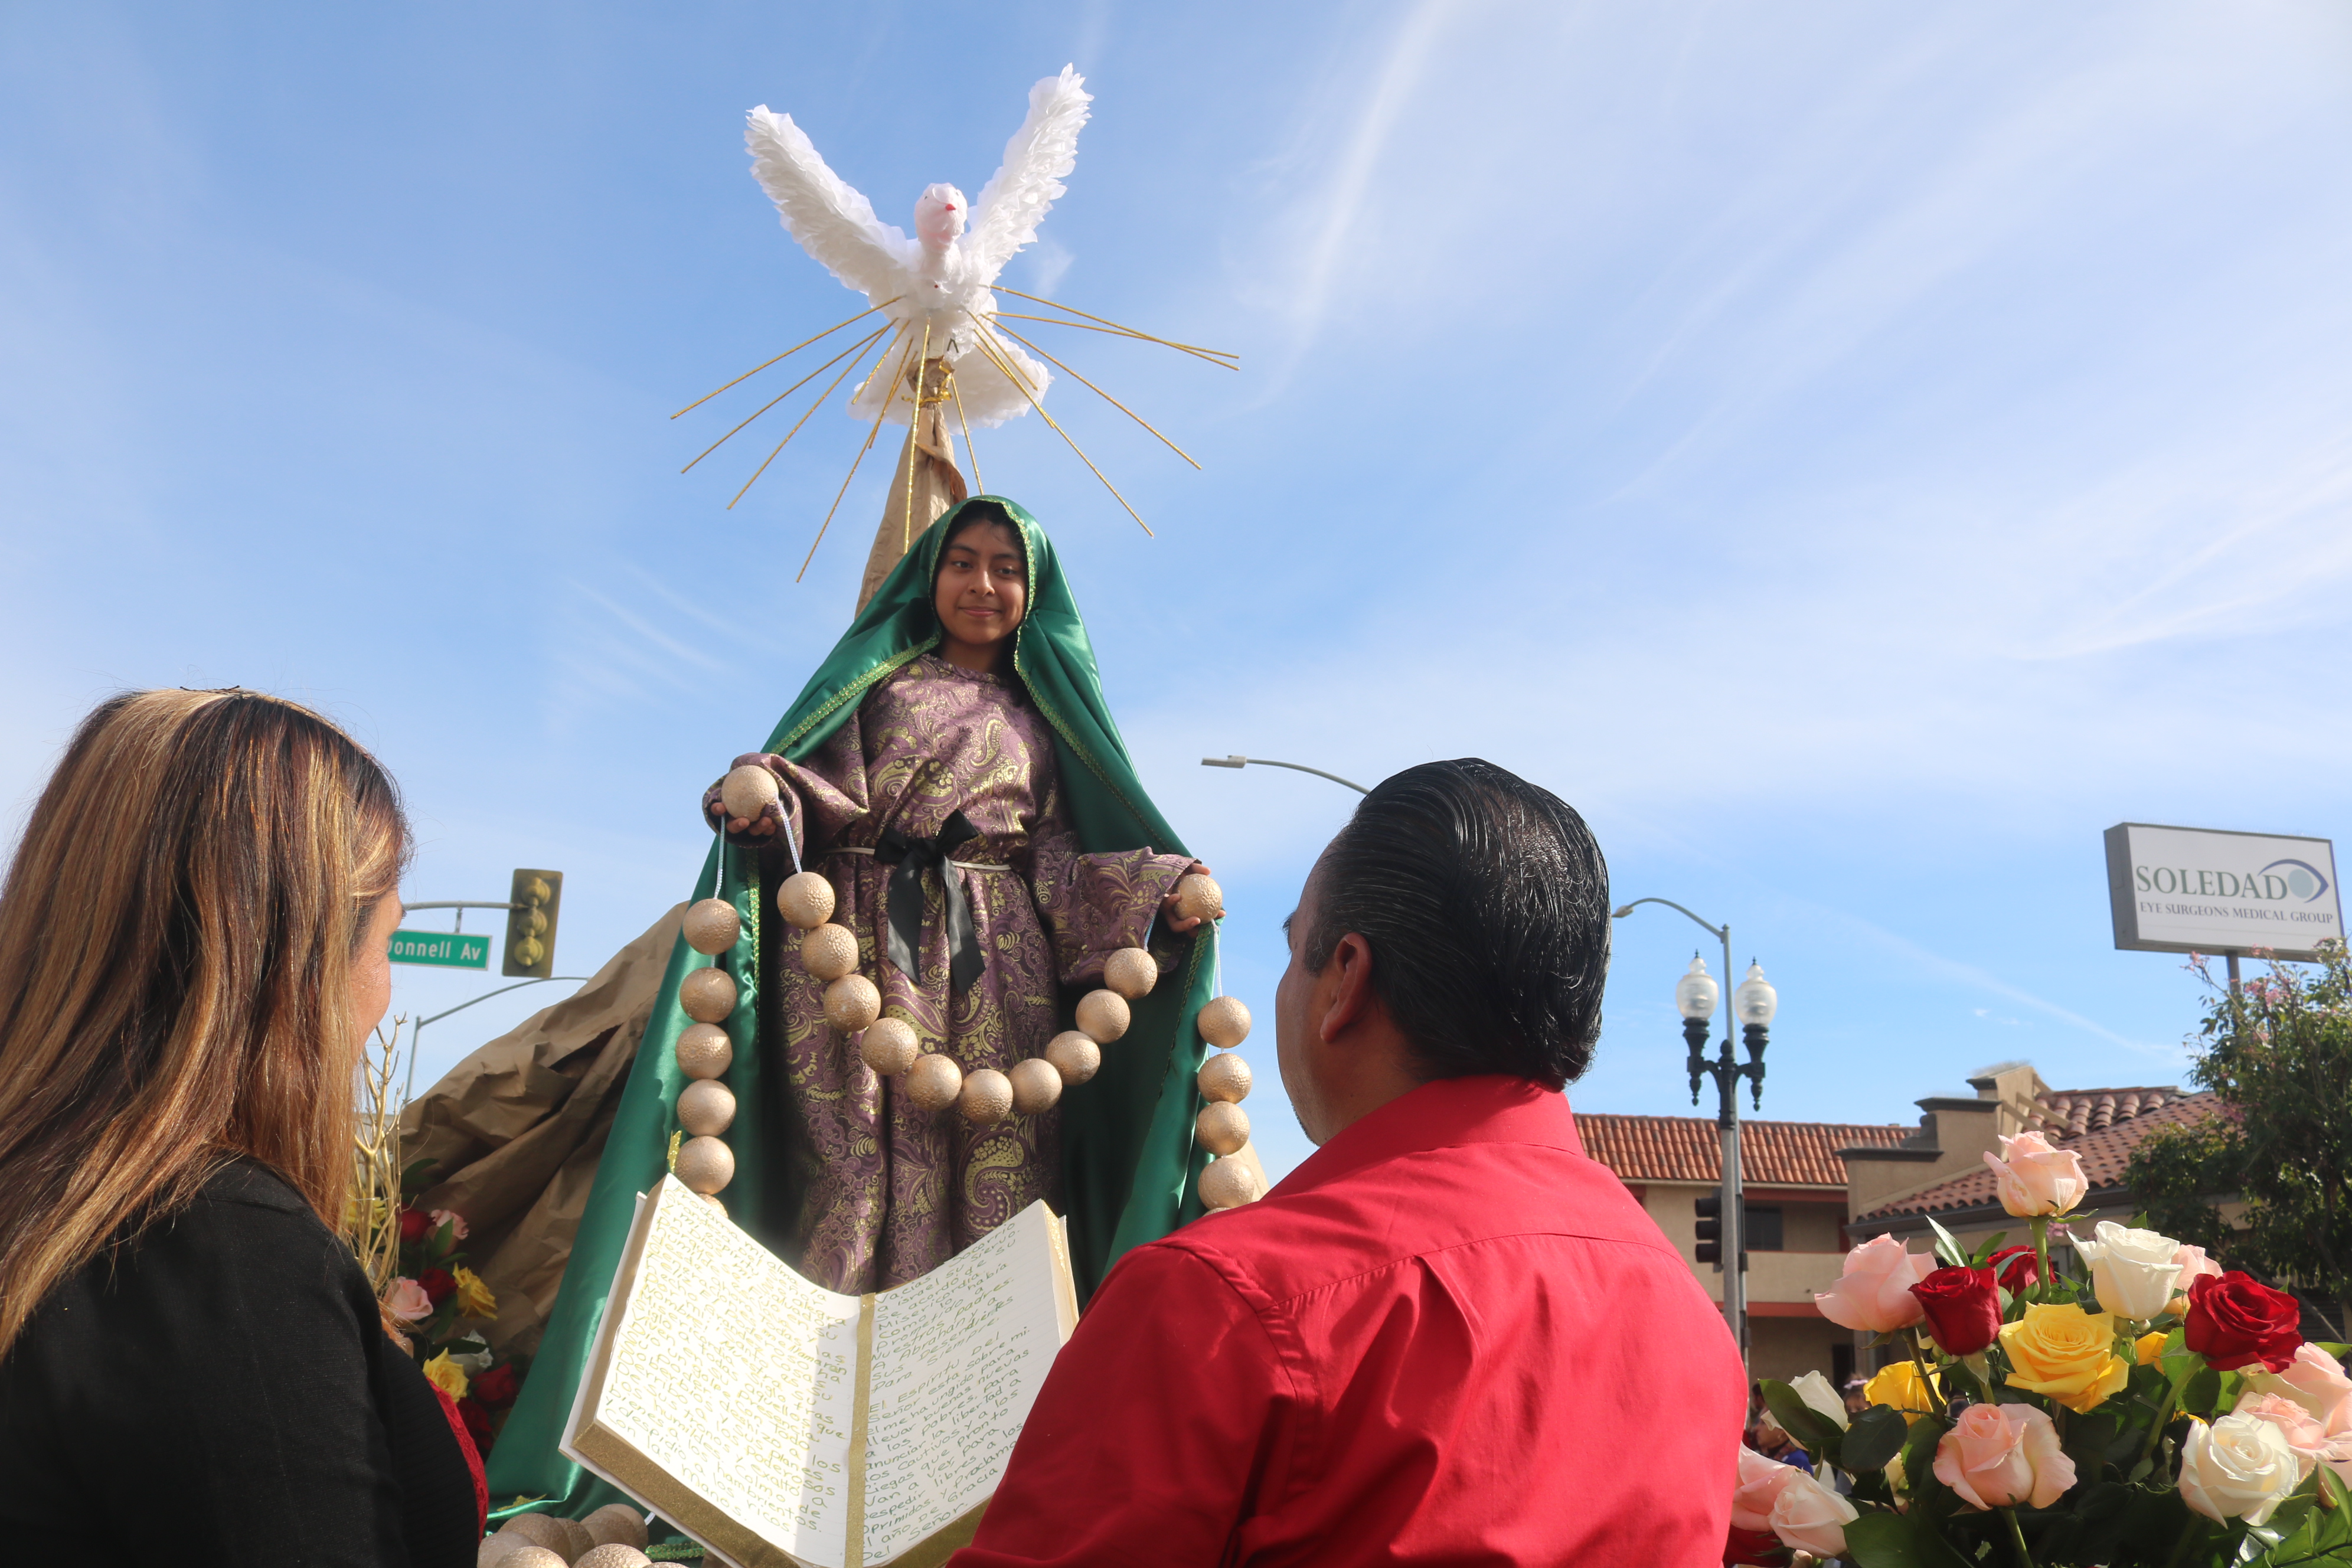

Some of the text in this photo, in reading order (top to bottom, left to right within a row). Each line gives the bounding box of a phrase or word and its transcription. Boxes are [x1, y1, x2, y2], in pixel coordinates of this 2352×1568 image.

[2136, 865, 2288, 900] SOLEDAD
[2140, 901, 2333, 924] EYE SURGEONS MEDICAL GROUP
[460, 943, 481, 961] Av
[664, 1188, 730, 1243] Grandeza
[769, 1269, 823, 1305] Señor
[673, 1185, 826, 1301] Proclama mi alma la
[645, 1259, 698, 1301] hecho
[648, 1242, 756, 1327] Generaciones
[655, 1224, 791, 1329] humilde esclava
[680, 1213, 702, 1229] mi
[705, 1232, 759, 1276] espíritu
[792, 1298, 846, 1326] alegra
[731, 1263, 752, 1279] mi
[965, 1260, 986, 1275] de
[651, 1234, 702, 1270] desde
[711, 1276, 753, 1313] ahora
[815, 1345, 846, 1364] las
[898, 1278, 939, 1306] israel
[940, 1298, 952, 1308] lo
[974, 1286, 984, 1295] a
[987, 1297, 998, 1306] a
[632, 1308, 676, 1347] Viven
[682, 1347, 703, 1367] en
[646, 1251, 691, 1285] Feliz
[699, 1289, 720, 1305] El
[817, 1368, 840, 1384] ha
[787, 1314, 809, 1331] en
[639, 1289, 734, 1367] Misericordia
[793, 1402, 834, 1425] tras
[871, 1320, 945, 1361] Nuestros
[620, 1341, 713, 1413] Soberbios
[667, 1347, 687, 1366] un
[691, 1364, 731, 1398] golpe
[678, 1331, 689, 1342] a
[744, 1383, 811, 1427] aquellos
[816, 1423, 846, 1440] que
[780, 1373, 799, 1387] es
[923, 1386, 971, 1422] buenas
[977, 1349, 1029, 1385] nuevas
[932, 1373, 974, 1406] ungido
[617, 1350, 688, 1404] Derribo
[695, 1407, 707, 1421] a
[716, 1420, 739, 1446] los
[868, 1397, 920, 1422] Señor
[928, 1372, 960, 1395] esta
[869, 1399, 887, 1413] El
[932, 1429, 946, 1440] la
[1009, 1378, 1022, 1387] a
[978, 1411, 988, 1419] a
[995, 1389, 1018, 1408] los
[615, 1373, 643, 1400] los
[798, 1504, 821, 1519] de
[647, 1435, 671, 1464] las
[718, 1400, 782, 1449] deshizo
[789, 1448, 801, 1461] a
[812, 1454, 841, 1473] los
[887, 1438, 911, 1452] los
[934, 1423, 1023, 1487] libres a los
[609, 1383, 822, 1533] bienes a los hambrientos.
[683, 1409, 730, 1453] tronos
[811, 1497, 828, 1509] a
[920, 1449, 950, 1471] que
[694, 1462, 705, 1476] a
[713, 1472, 734, 1498] los
[908, 1482, 919, 1491] a
[881, 1524, 911, 1543] año
